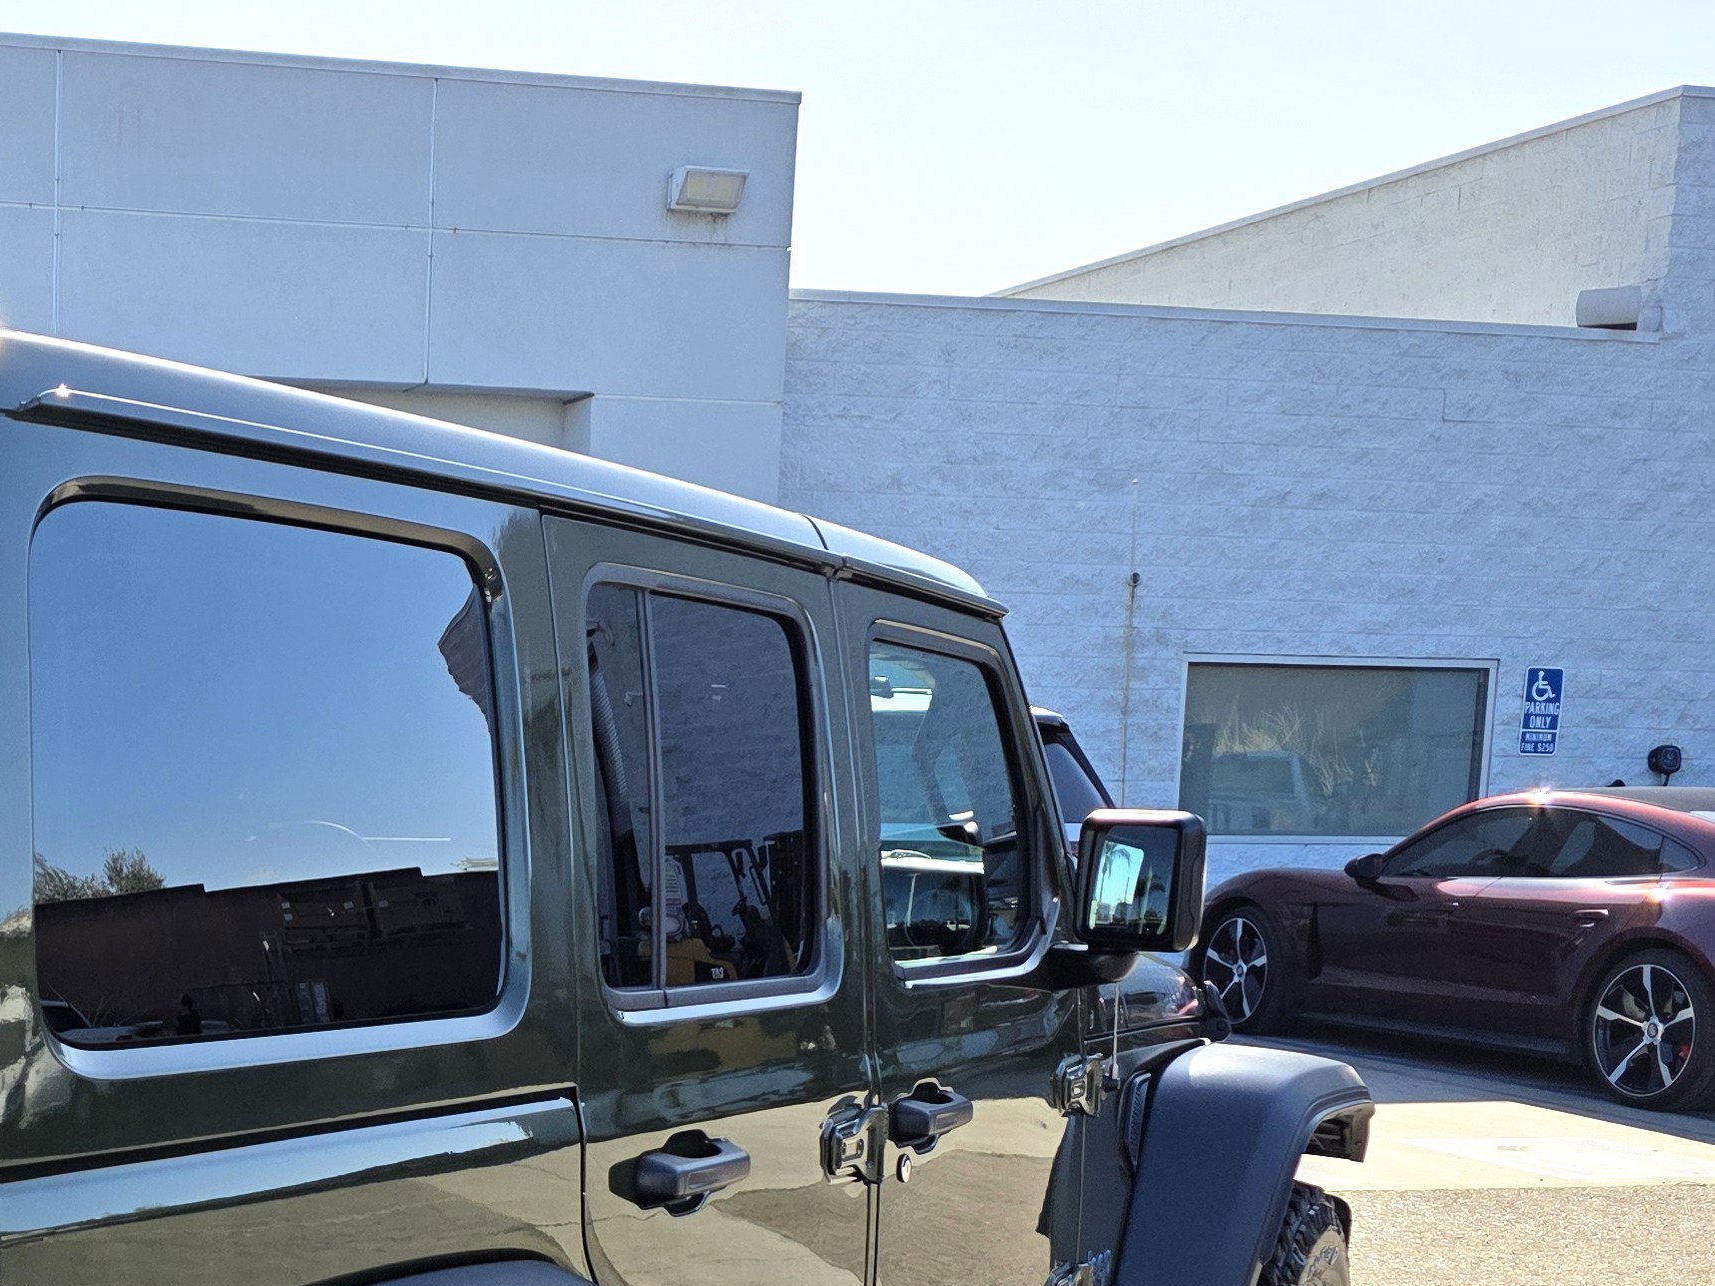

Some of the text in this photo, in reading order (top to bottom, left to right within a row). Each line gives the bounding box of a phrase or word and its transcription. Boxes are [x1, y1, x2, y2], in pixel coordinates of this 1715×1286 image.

[1525, 701, 1560, 715] PARKING
[1529, 715, 1552, 728] ONLY
[1520, 743, 1534, 751] FINE
